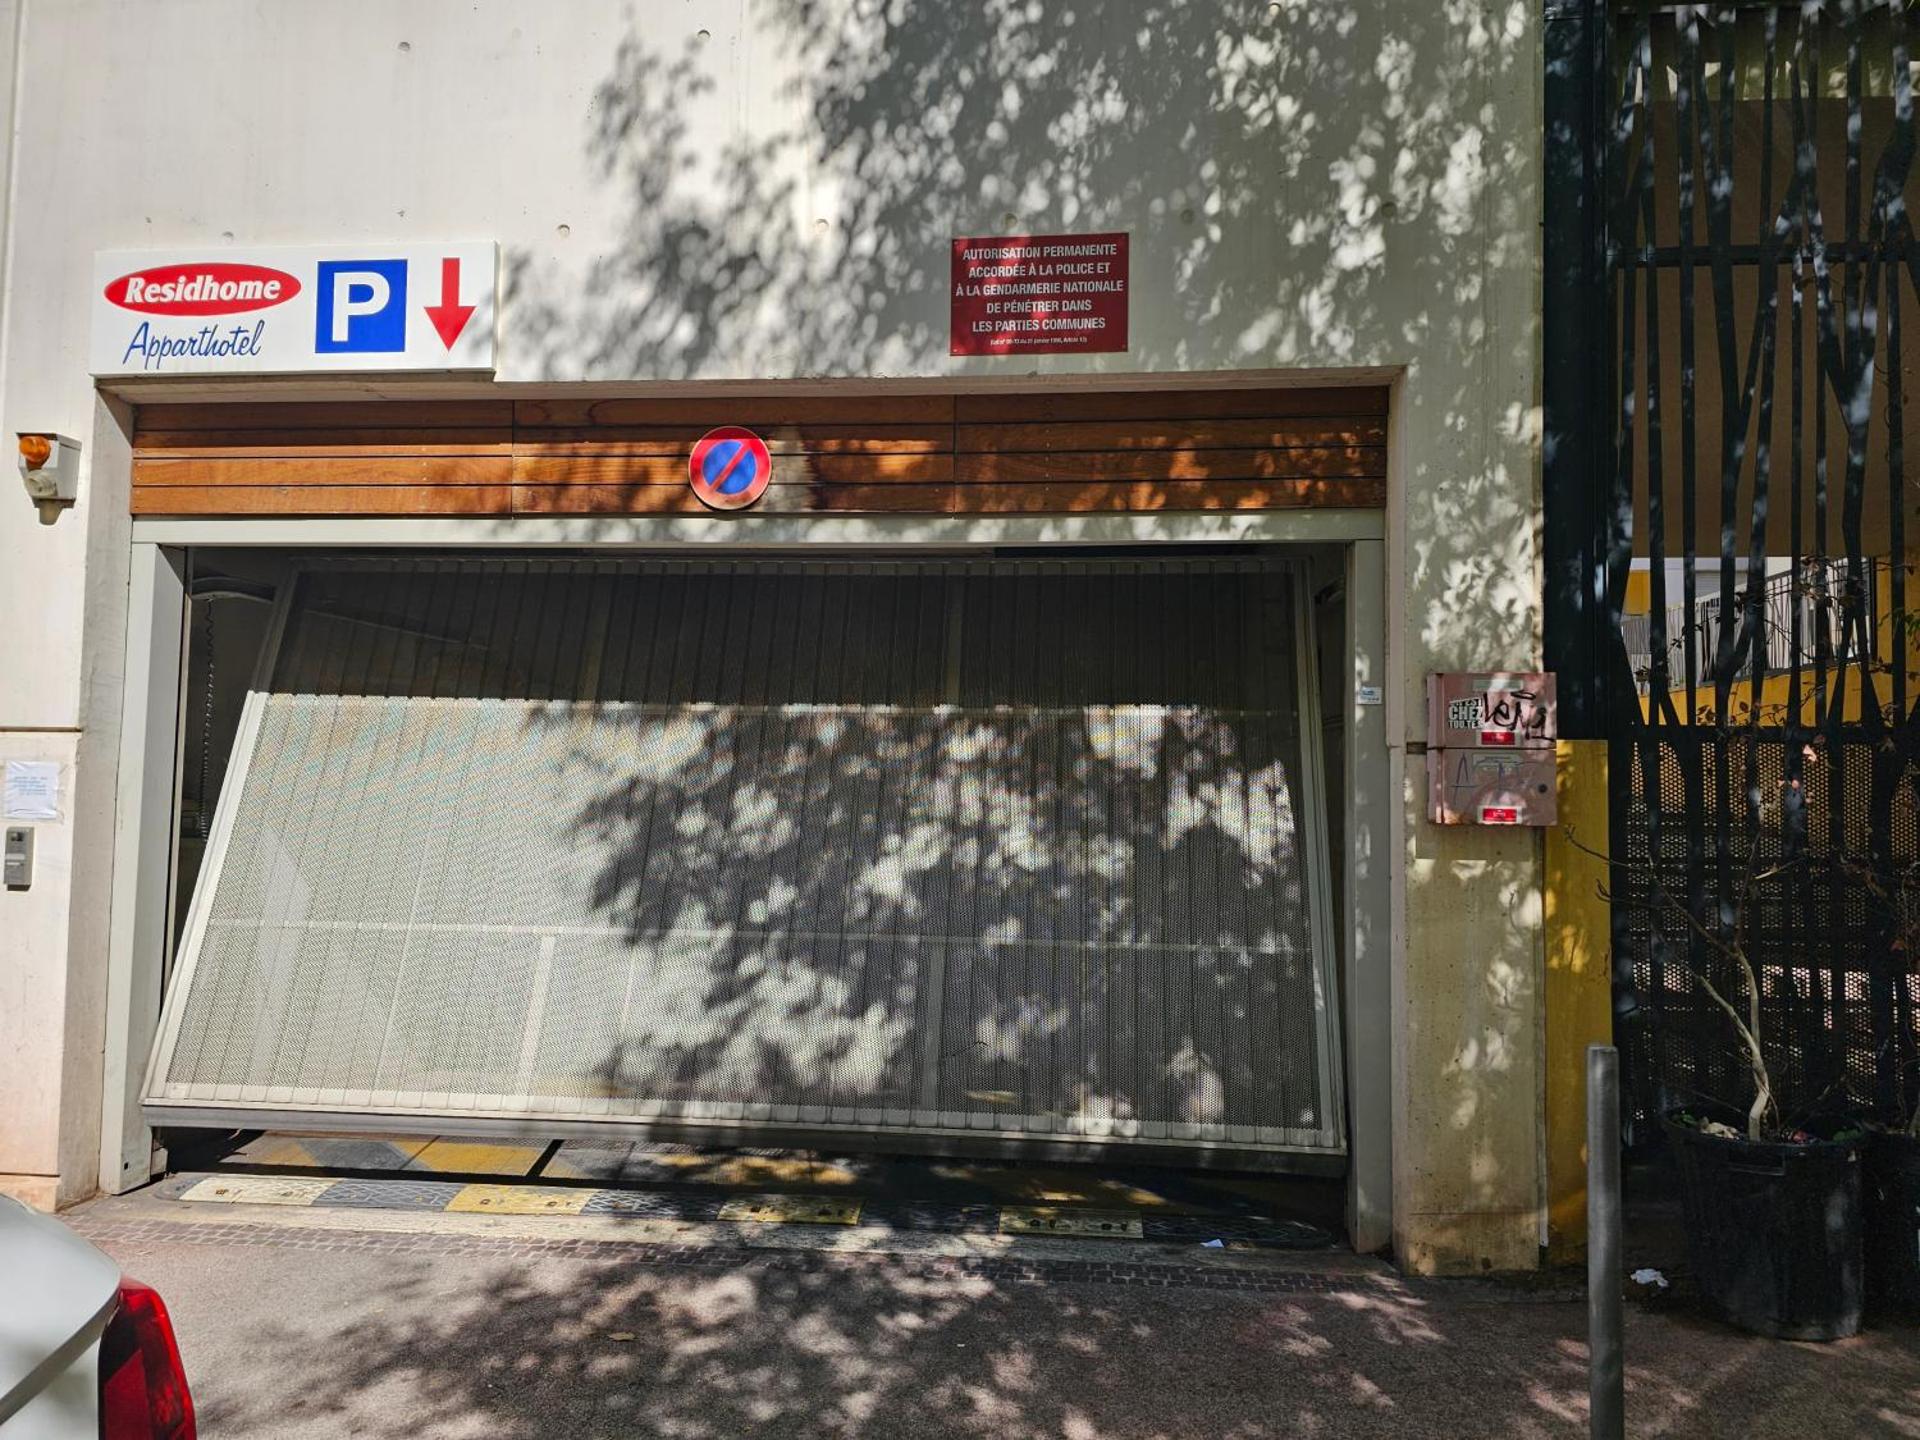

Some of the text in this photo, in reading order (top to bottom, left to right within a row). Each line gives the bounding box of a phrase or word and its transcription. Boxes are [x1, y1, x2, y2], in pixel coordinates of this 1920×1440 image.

[963, 244, 1117, 260] AUTORISATION PERMANENTE
[969, 262, 1111, 278] ACCORDÉE À LA POLICE ET
[125, 275, 281, 303] Residhome
[956, 280, 1124, 296] À LA GENDARMERIE NATIONALE
[331, 271, 391, 342] P
[986, 299, 1092, 314] DE PÉNÉTRER DANS
[972, 317, 1106, 332] LES PARTIES COMMUNES
[122, 319, 266, 370] Apparthotel
